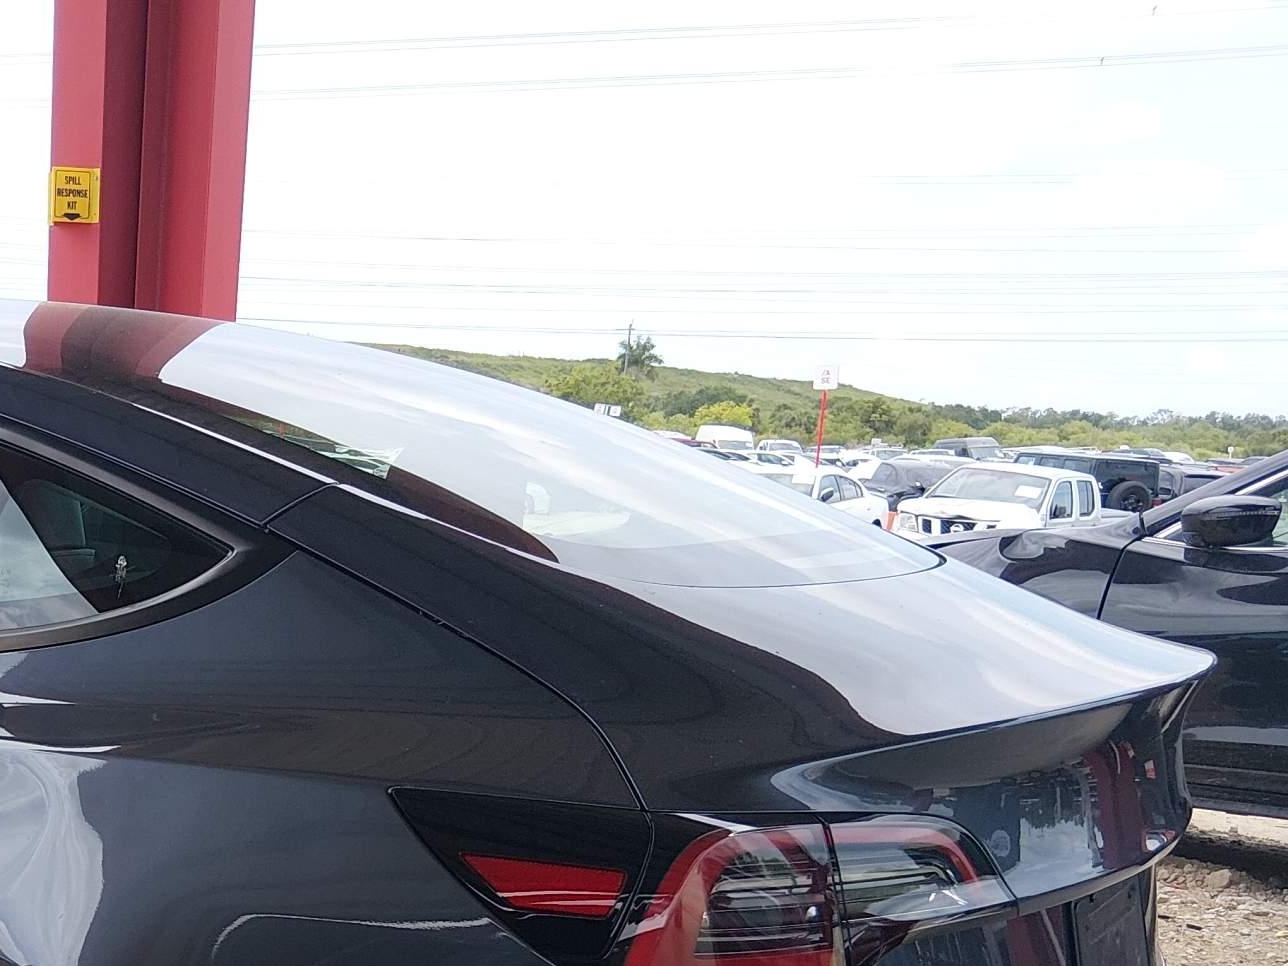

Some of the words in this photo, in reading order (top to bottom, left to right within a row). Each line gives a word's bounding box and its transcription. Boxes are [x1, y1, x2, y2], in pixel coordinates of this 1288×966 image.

[64, 175, 82, 185] SPILL
[56, 187, 88, 198] RESPONSE
[67, 200, 77, 210] KIT
